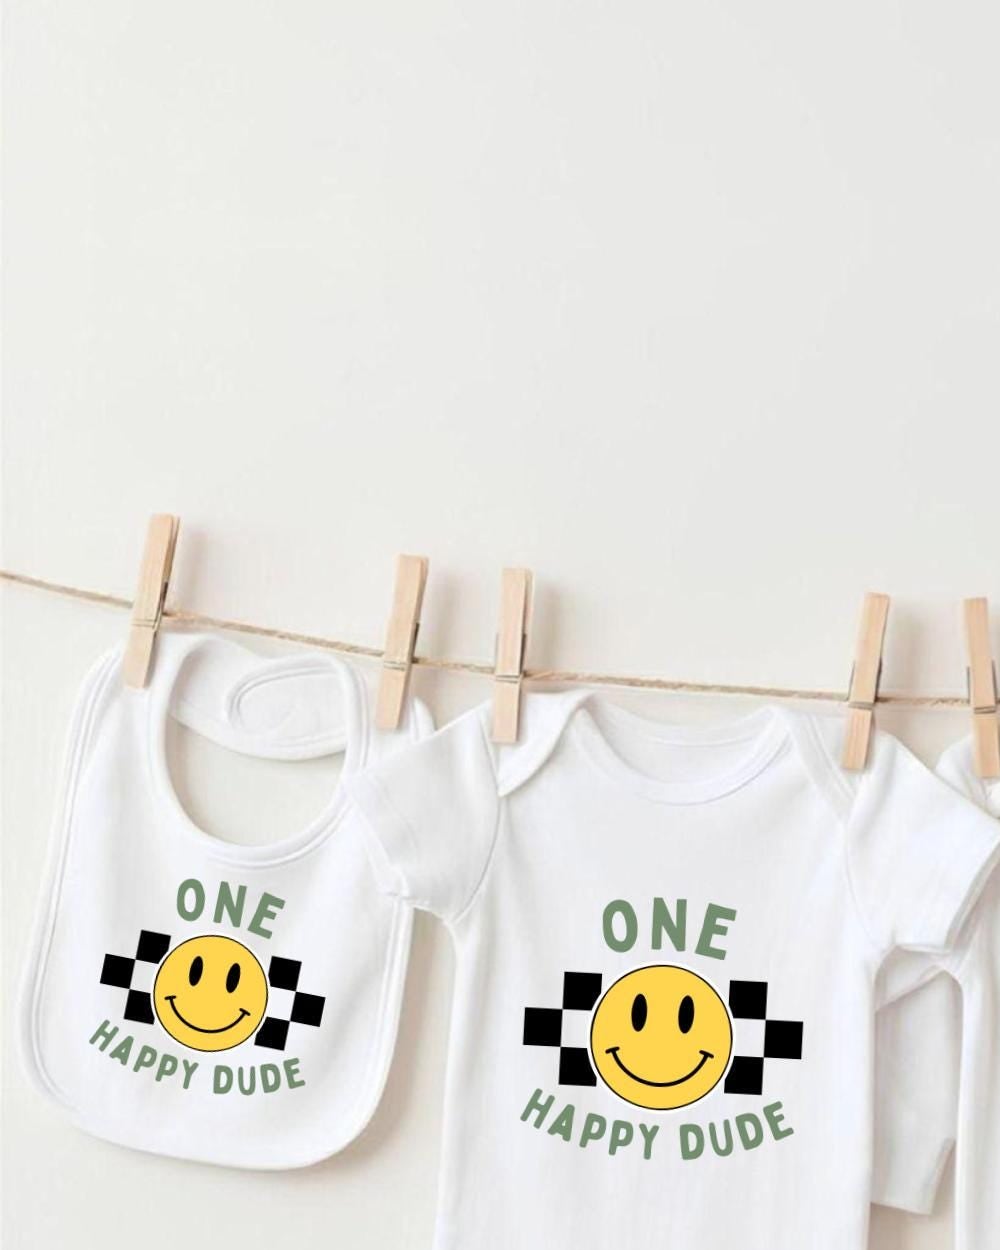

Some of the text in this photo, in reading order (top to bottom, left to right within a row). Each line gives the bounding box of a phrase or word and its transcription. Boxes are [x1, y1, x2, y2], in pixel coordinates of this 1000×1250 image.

[175, 878, 286, 940] ONE
[601, 896, 737, 960] ONE
[88, 1021, 305, 1095] HAPPY DUDE
[520, 1088, 793, 1162] HAPPY DUDE
